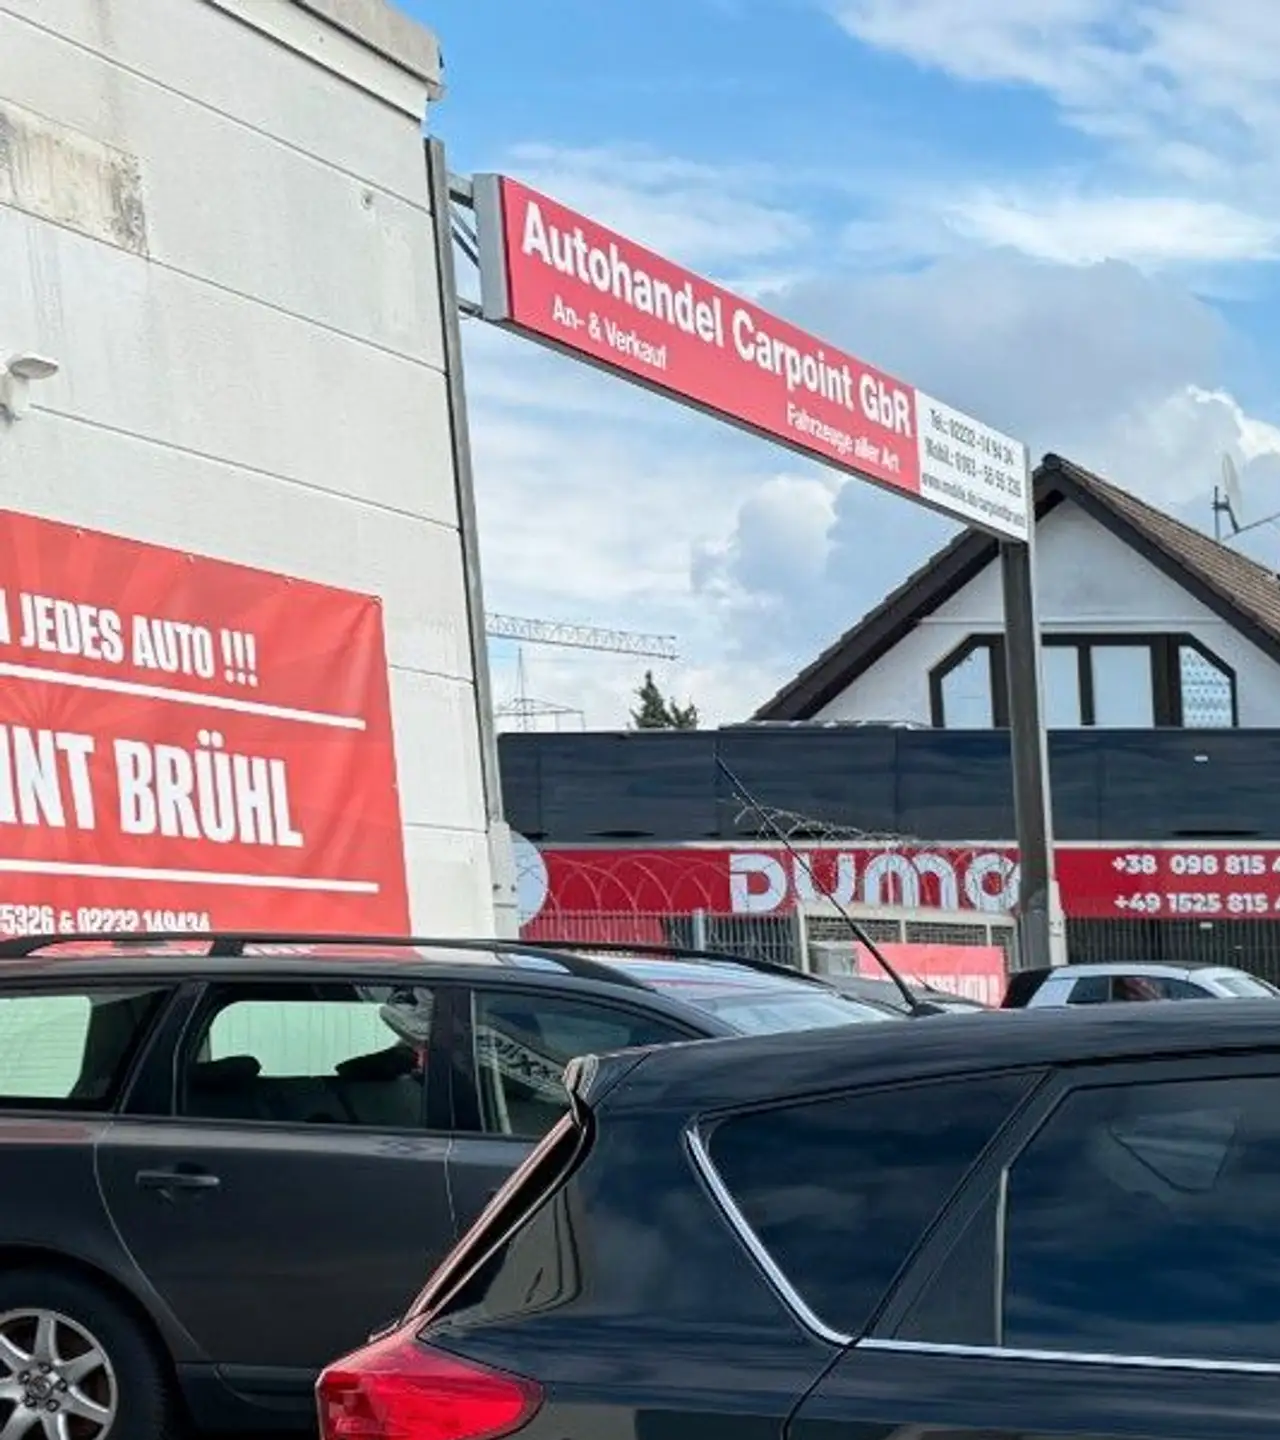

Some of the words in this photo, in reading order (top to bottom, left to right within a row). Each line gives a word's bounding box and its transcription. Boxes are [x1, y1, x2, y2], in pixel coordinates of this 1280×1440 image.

[522, 201, 724, 347] Autohandel
[732, 308, 854, 412] Carpoint
[859, 372, 912, 439] GbR
[552, 293, 585, 331] An-
[588, 311, 602, 343] &
[603, 317, 667, 371] Verkauf
[787, 400, 853, 456] Fahrzeuge
[881, 444, 900, 474] Art
[20, 592, 123, 663] JEDES
[132, 614, 215, 678] AUTO
[220, 628, 258, 687] !!!
[113, 730, 303, 847] BRÜHL
[1111, 854, 1157, 874] +38
[1169, 854, 1218, 875] 098
[1225, 854, 1265, 875] 815
[1114, 892, 1160, 913] +49
[1166, 892, 1220, 913] 1525
[1227, 892, 1268, 913] 815
